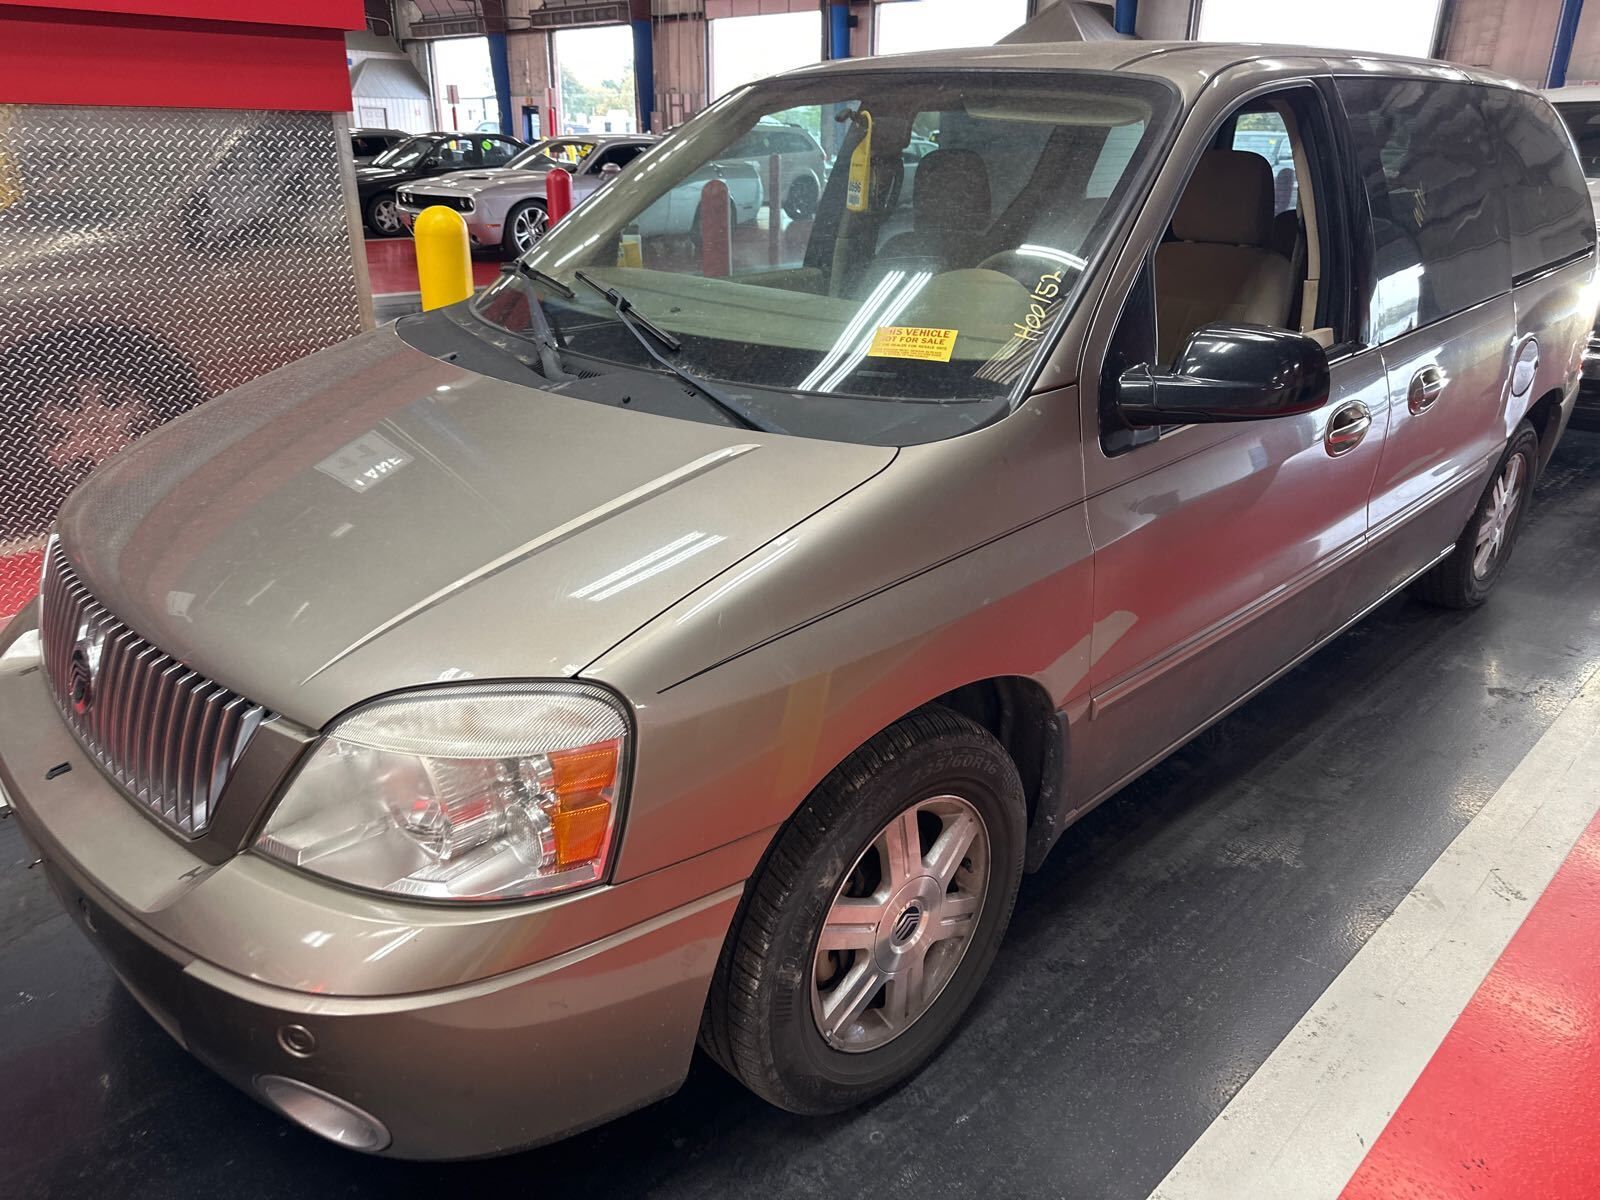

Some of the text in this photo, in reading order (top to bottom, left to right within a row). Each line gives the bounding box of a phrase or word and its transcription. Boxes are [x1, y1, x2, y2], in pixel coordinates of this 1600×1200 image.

[906, 328, 951, 339] VEHICLE
[899, 336, 918, 344] FOR
[921, 337, 946, 345] SALE
